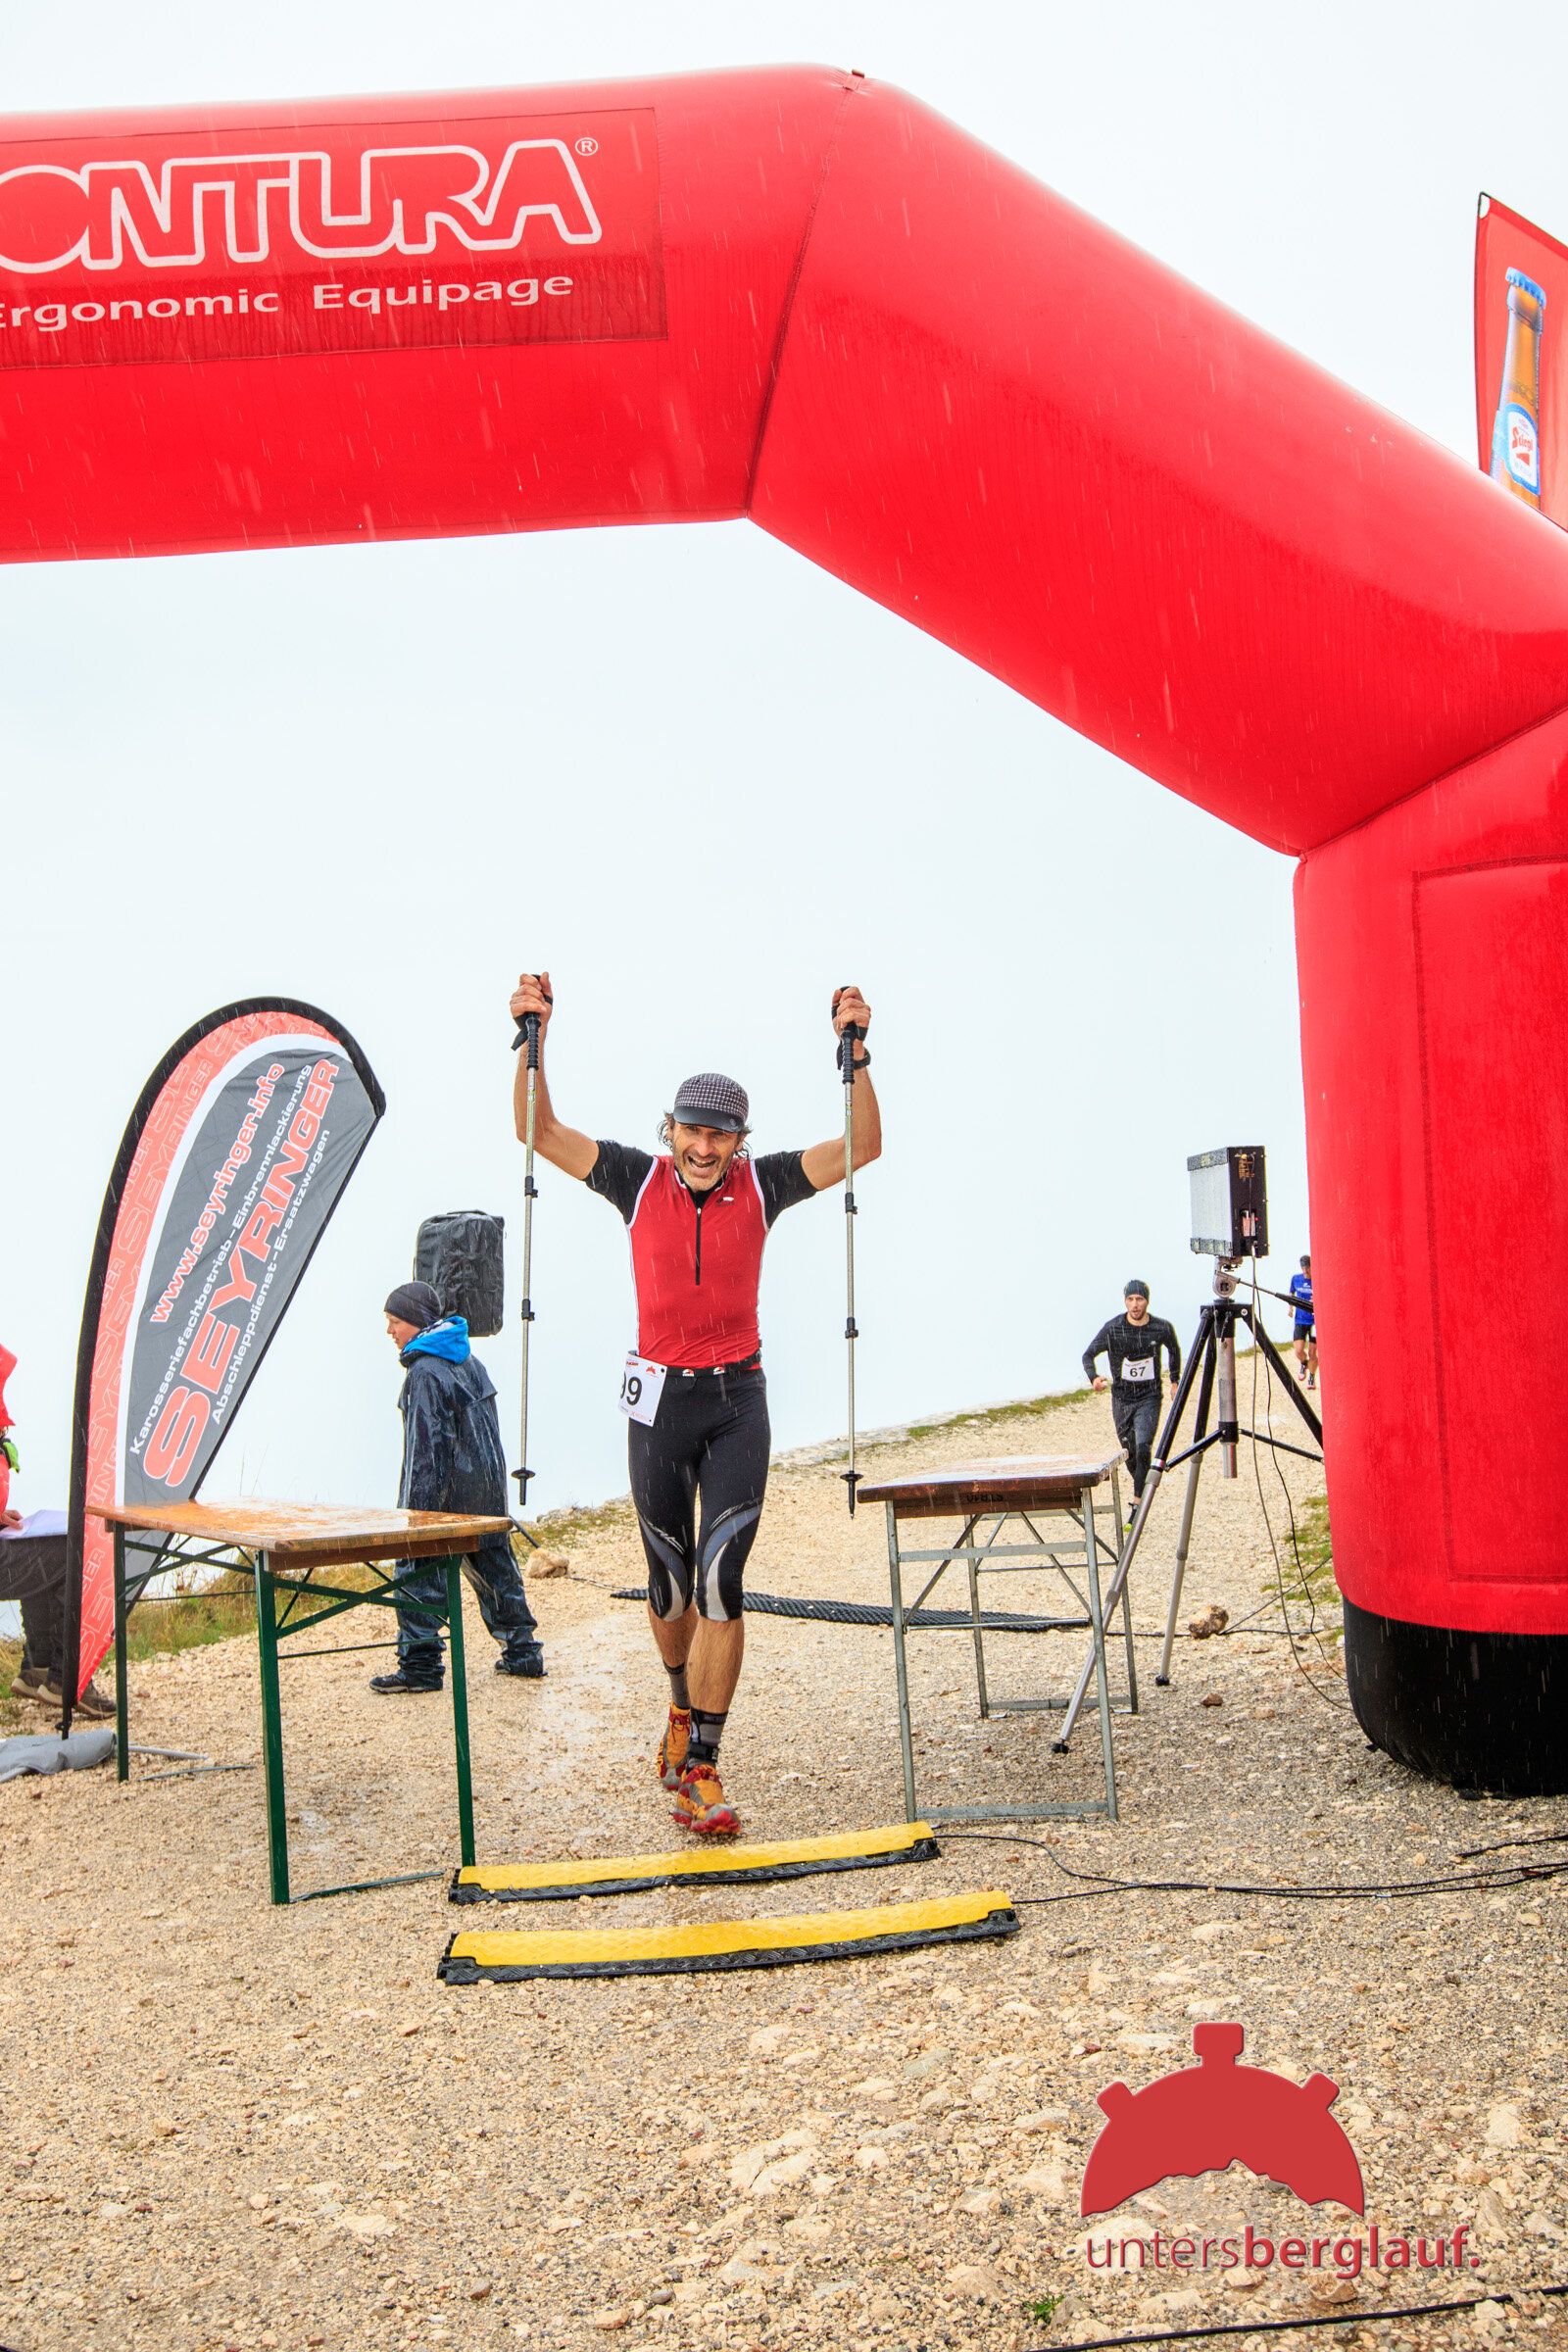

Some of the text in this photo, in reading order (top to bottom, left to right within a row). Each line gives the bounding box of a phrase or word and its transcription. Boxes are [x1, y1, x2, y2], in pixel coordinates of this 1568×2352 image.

[0, 273, 574, 333] rgonomic Equipage
[142, 1058, 340, 1488] SEYRINGER
[149, 1062, 285, 1325] www.seyringer.info
[1130, 1366, 1146, 1377] 67
